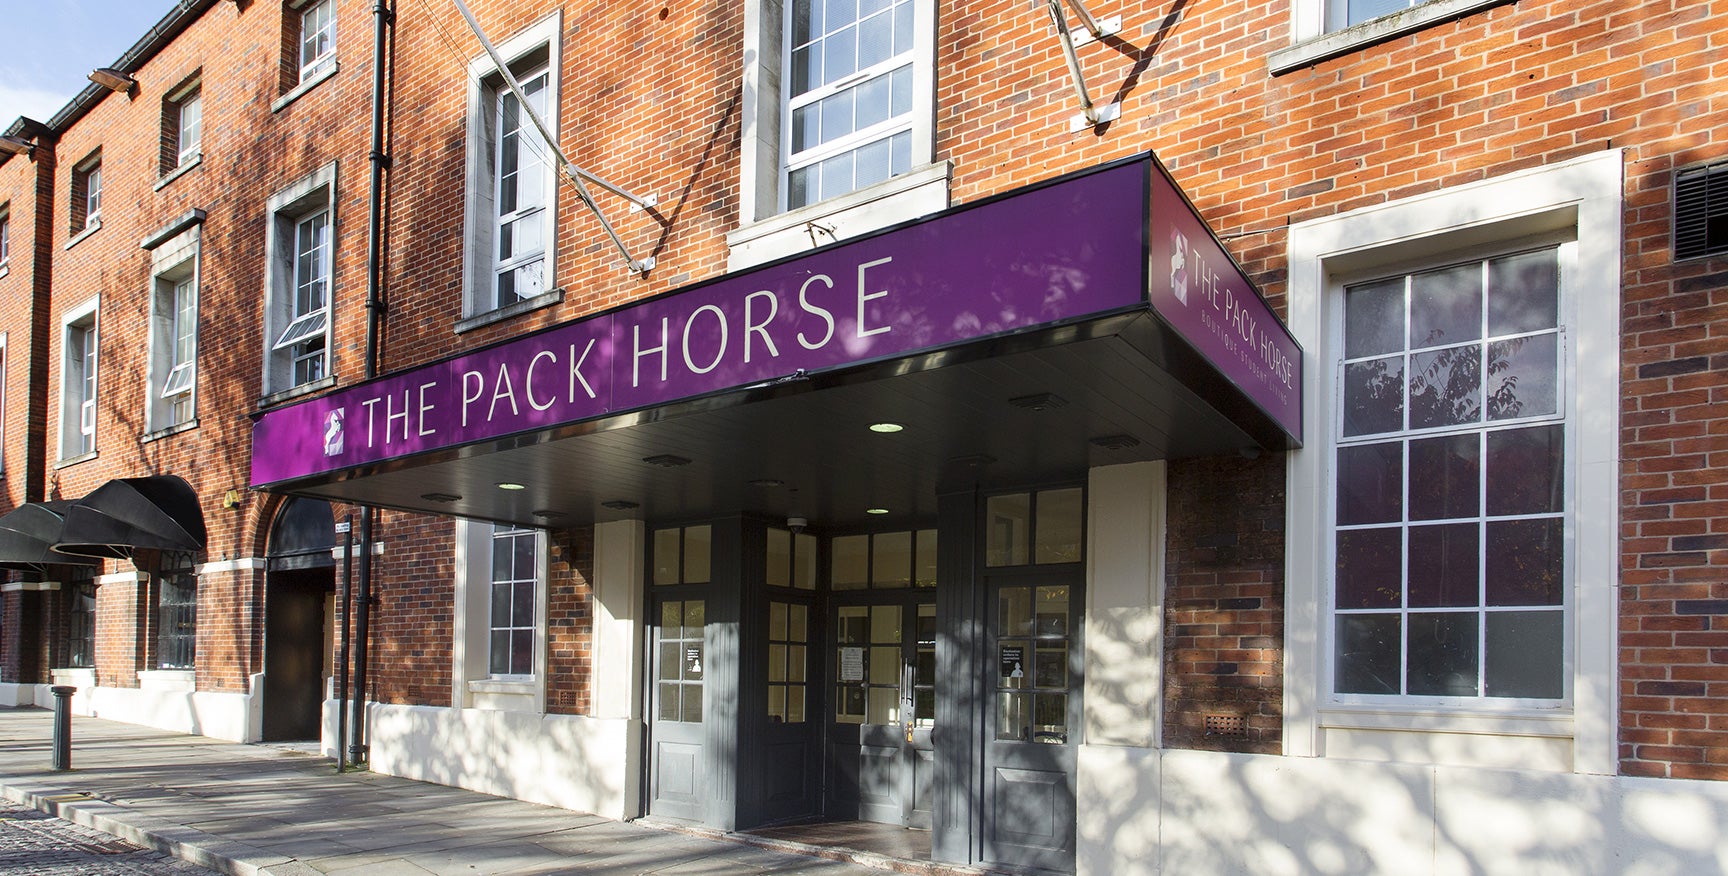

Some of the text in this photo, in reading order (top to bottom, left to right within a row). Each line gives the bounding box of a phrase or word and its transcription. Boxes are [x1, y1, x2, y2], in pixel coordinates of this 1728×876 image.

[362, 256, 894, 448] THE PACK HORSE
[1193, 249, 1293, 390] THE PACK HORSE
[1201, 309, 1288, 406] BOUTIQUE STUDENT LIVING
